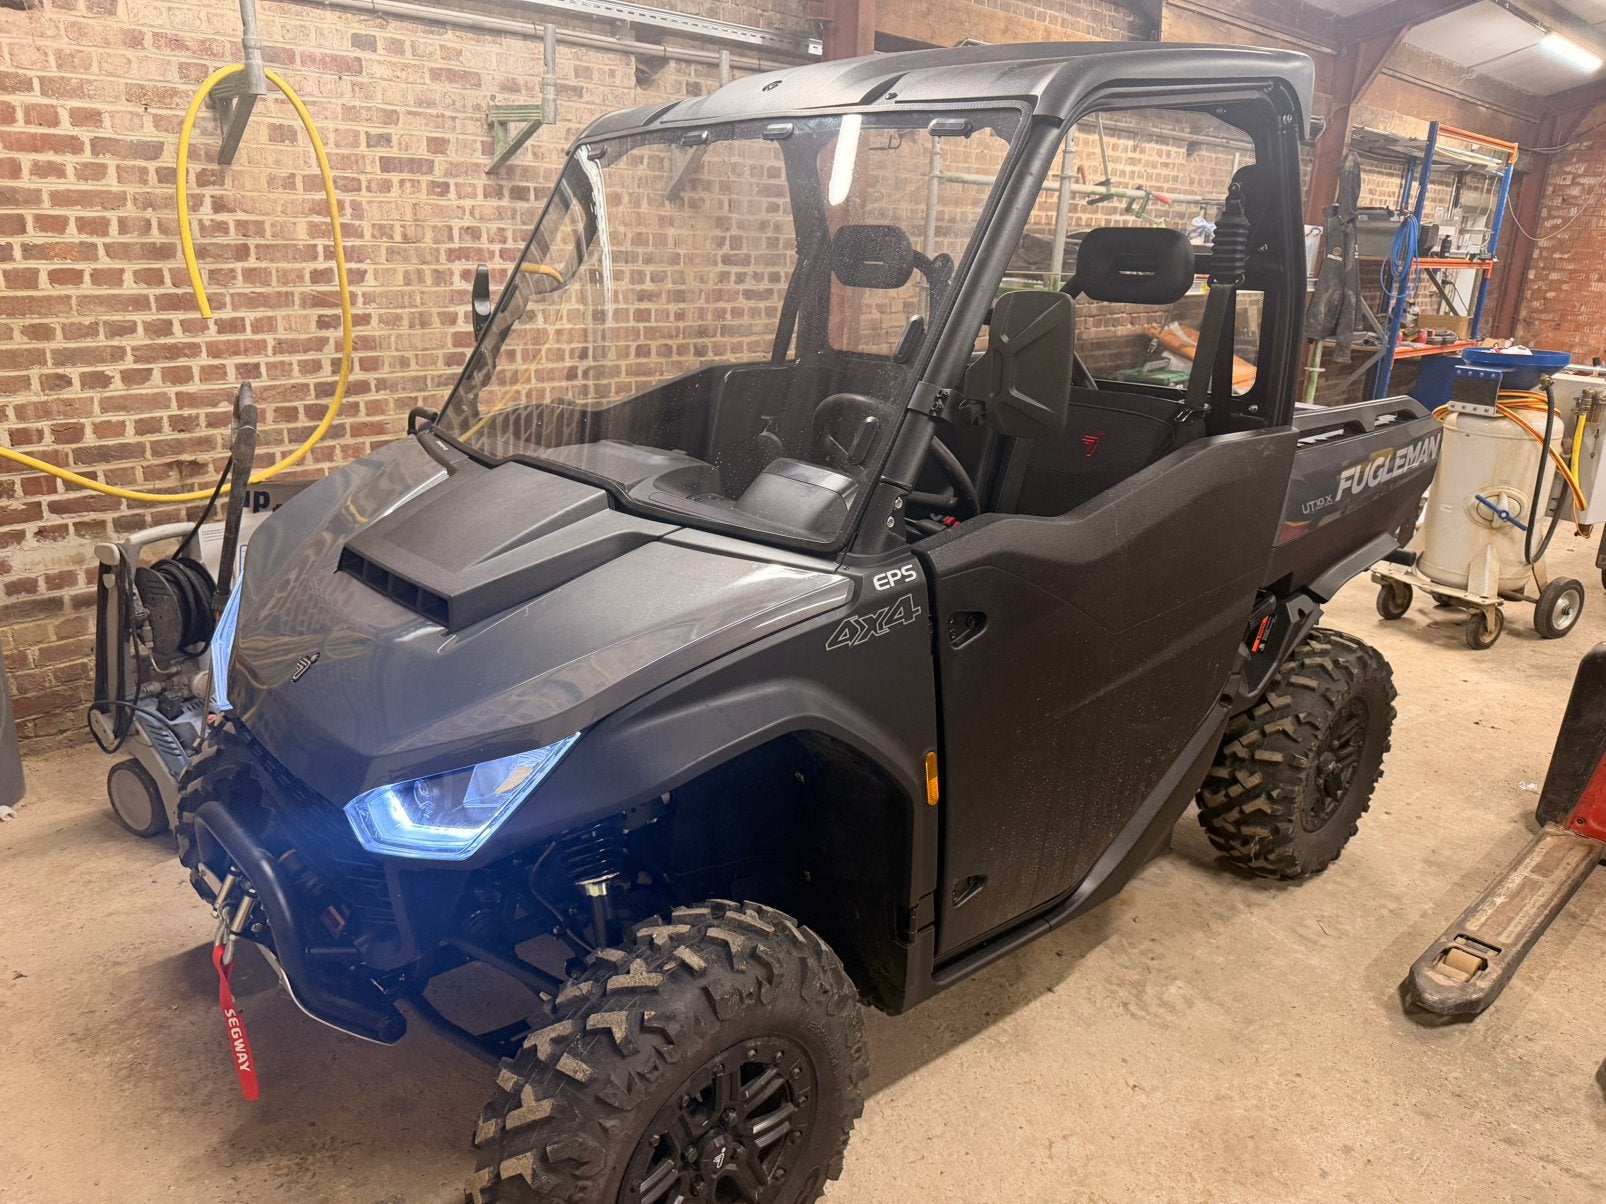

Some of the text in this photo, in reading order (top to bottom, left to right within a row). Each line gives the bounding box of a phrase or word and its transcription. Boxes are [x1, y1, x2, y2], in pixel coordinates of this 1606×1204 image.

[1335, 433, 1441, 502] FUGLEMAN
[873, 564, 917, 590] EPS
[224, 1008, 251, 1072] SEGWAY
